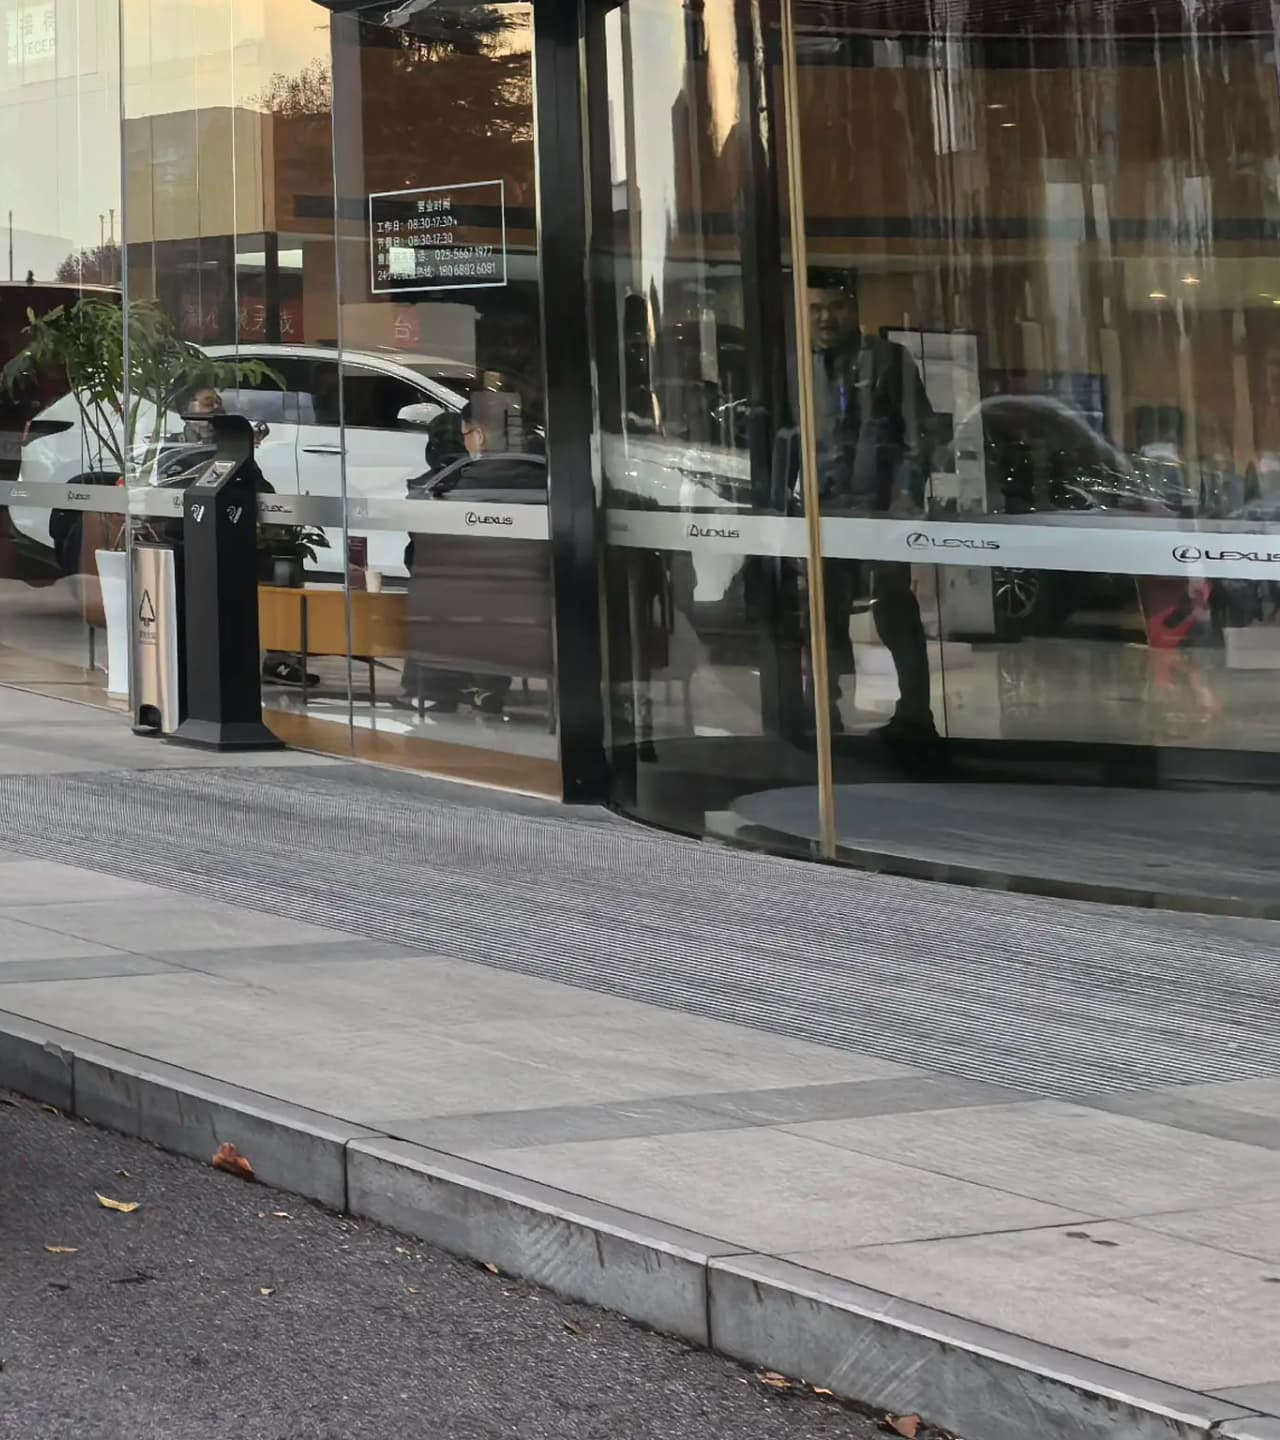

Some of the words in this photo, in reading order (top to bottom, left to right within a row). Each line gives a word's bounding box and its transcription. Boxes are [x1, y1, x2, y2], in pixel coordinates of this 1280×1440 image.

[477, 515, 513, 526] LEXUS
[700, 528, 740, 539] LEXUS
[932, 537, 1001, 550] LEXUS
